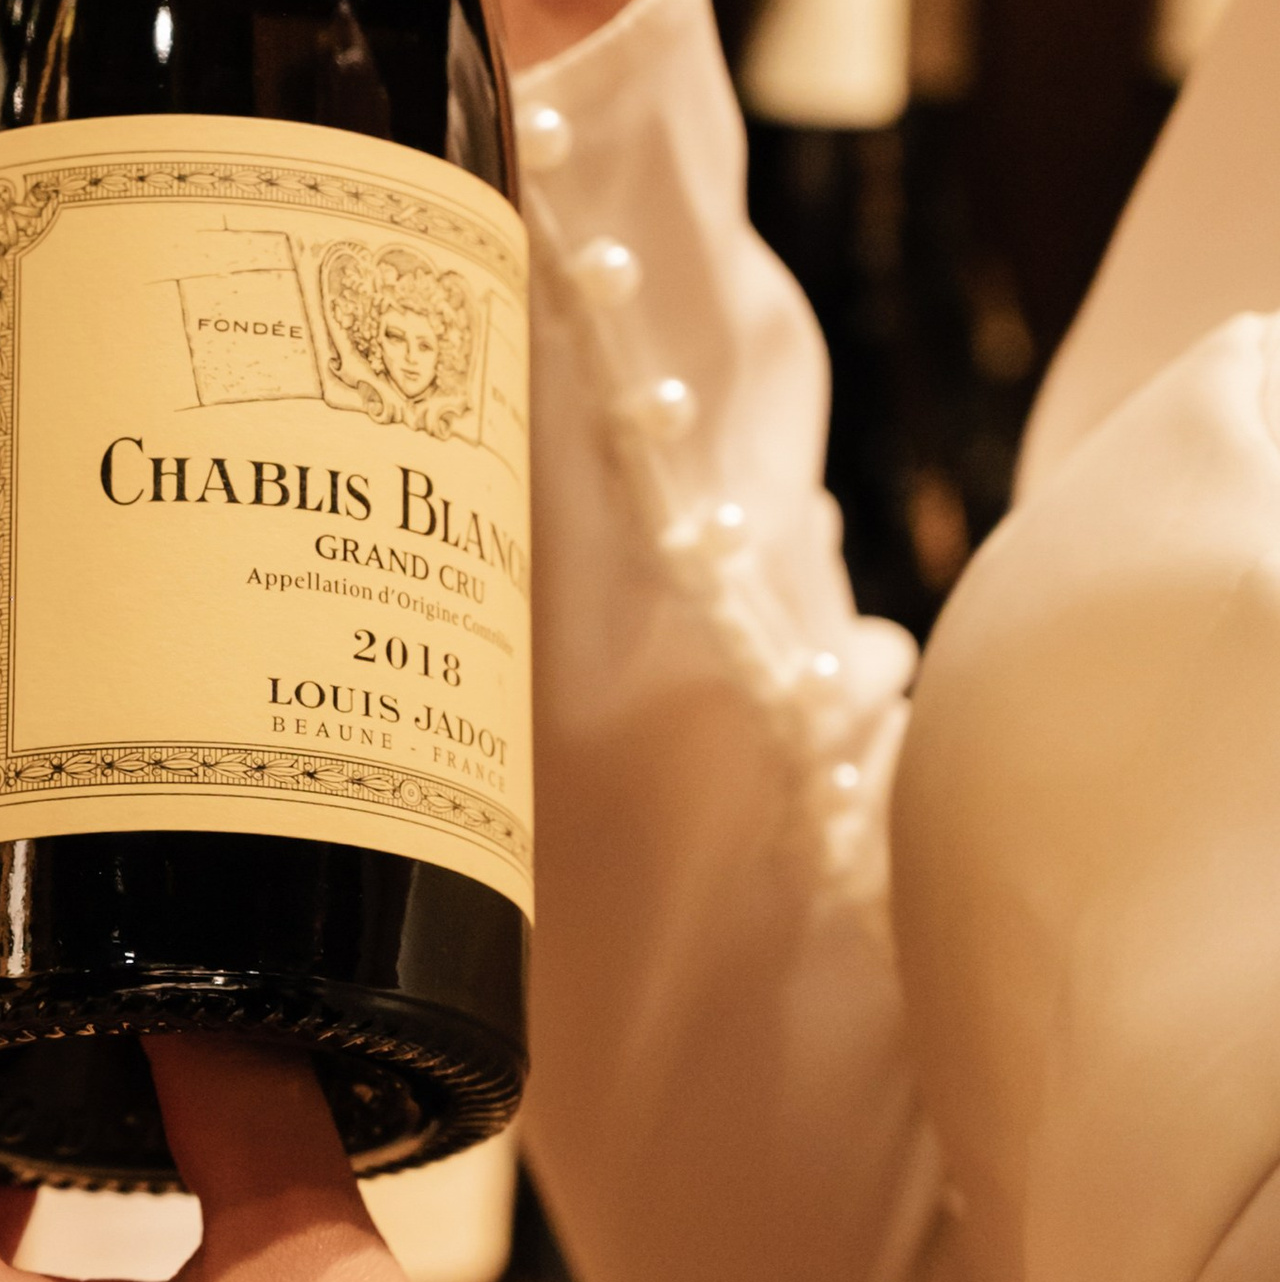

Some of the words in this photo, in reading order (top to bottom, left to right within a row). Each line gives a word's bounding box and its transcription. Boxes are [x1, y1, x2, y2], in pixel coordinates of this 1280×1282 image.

[198, 318, 303, 339] FONDÉE
[100, 436, 372, 521] CHABLIS
[246, 567, 373, 601] Appellation
[378, 585, 460, 626] d'Origine
[314, 533, 430, 581] GRAND
[438, 564, 486, 605] CRU
[353, 628, 462, 688] 2018
[267, 676, 401, 724] LOUIS
[414, 704, 508, 767] JADOT
[272, 715, 393, 751] BEAUNE
[433, 745, 506, 794] FRANCE
